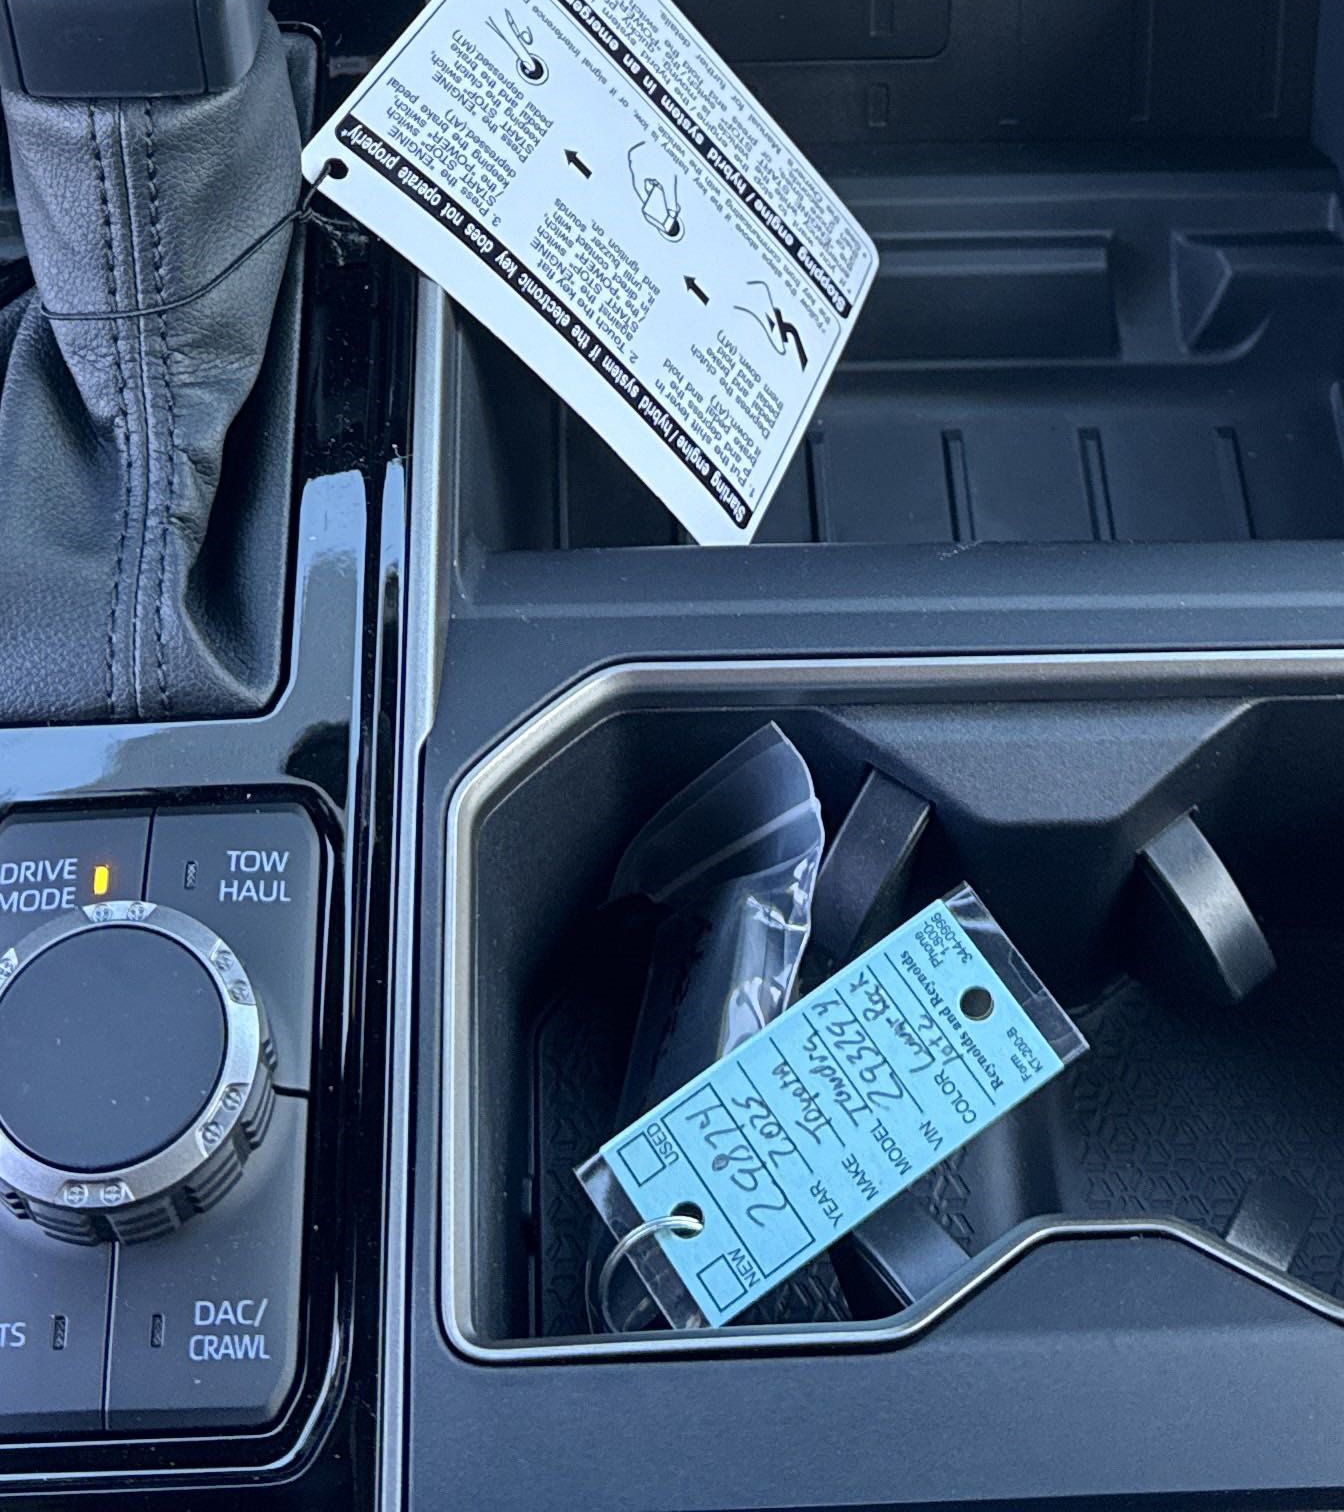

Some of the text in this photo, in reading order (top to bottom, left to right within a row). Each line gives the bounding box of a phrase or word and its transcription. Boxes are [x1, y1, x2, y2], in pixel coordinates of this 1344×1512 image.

[620, 51, 641, 76] an
[640, 73, 657, 95] in
[658, 91, 707, 148] system
[394, 162, 445, 209] operate
[705, 143, 748, 195] hybrid
[438, 200, 465, 229] not
[751, 195, 796, 248] engine
[460, 220, 495, 257] does
[491, 247, 520, 279] key
[793, 244, 848, 313] Stopping
[514, 270, 573, 331] electronic
[567, 323, 591, 350] the
[587, 343, 601, 361] if
[598, 353, 641, 401] system
[637, 394, 675, 437] hybrid
[674, 431, 712, 477] engine
[708, 468, 748, 523] Starting
[0, 858, 78, 885] DRIVE
[226, 849, 290, 873] TOW
[218, 879, 292, 904] HAUL
[912, 929, 943, 968] Phone
[897, 946, 1006, 1091] Reynolds and Reynolds
[1008, 1052, 1032, 1082] Form
[933, 1068, 977, 1125] COLOR
[645, 1120, 680, 1166] USED
[731, 1083, 798, 1168] 2025
[867, 1117, 912, 1175] MODEL
[918, 1119, 945, 1151] VIN
[841, 1153, 878, 1200] MAKE
[808, 1179, 845, 1227] YEAR
[727, 1244, 760, 1288] NEW
[193, 1299, 266, 1327] DAC/
[189, 1334, 270, 1361] CRAWL
